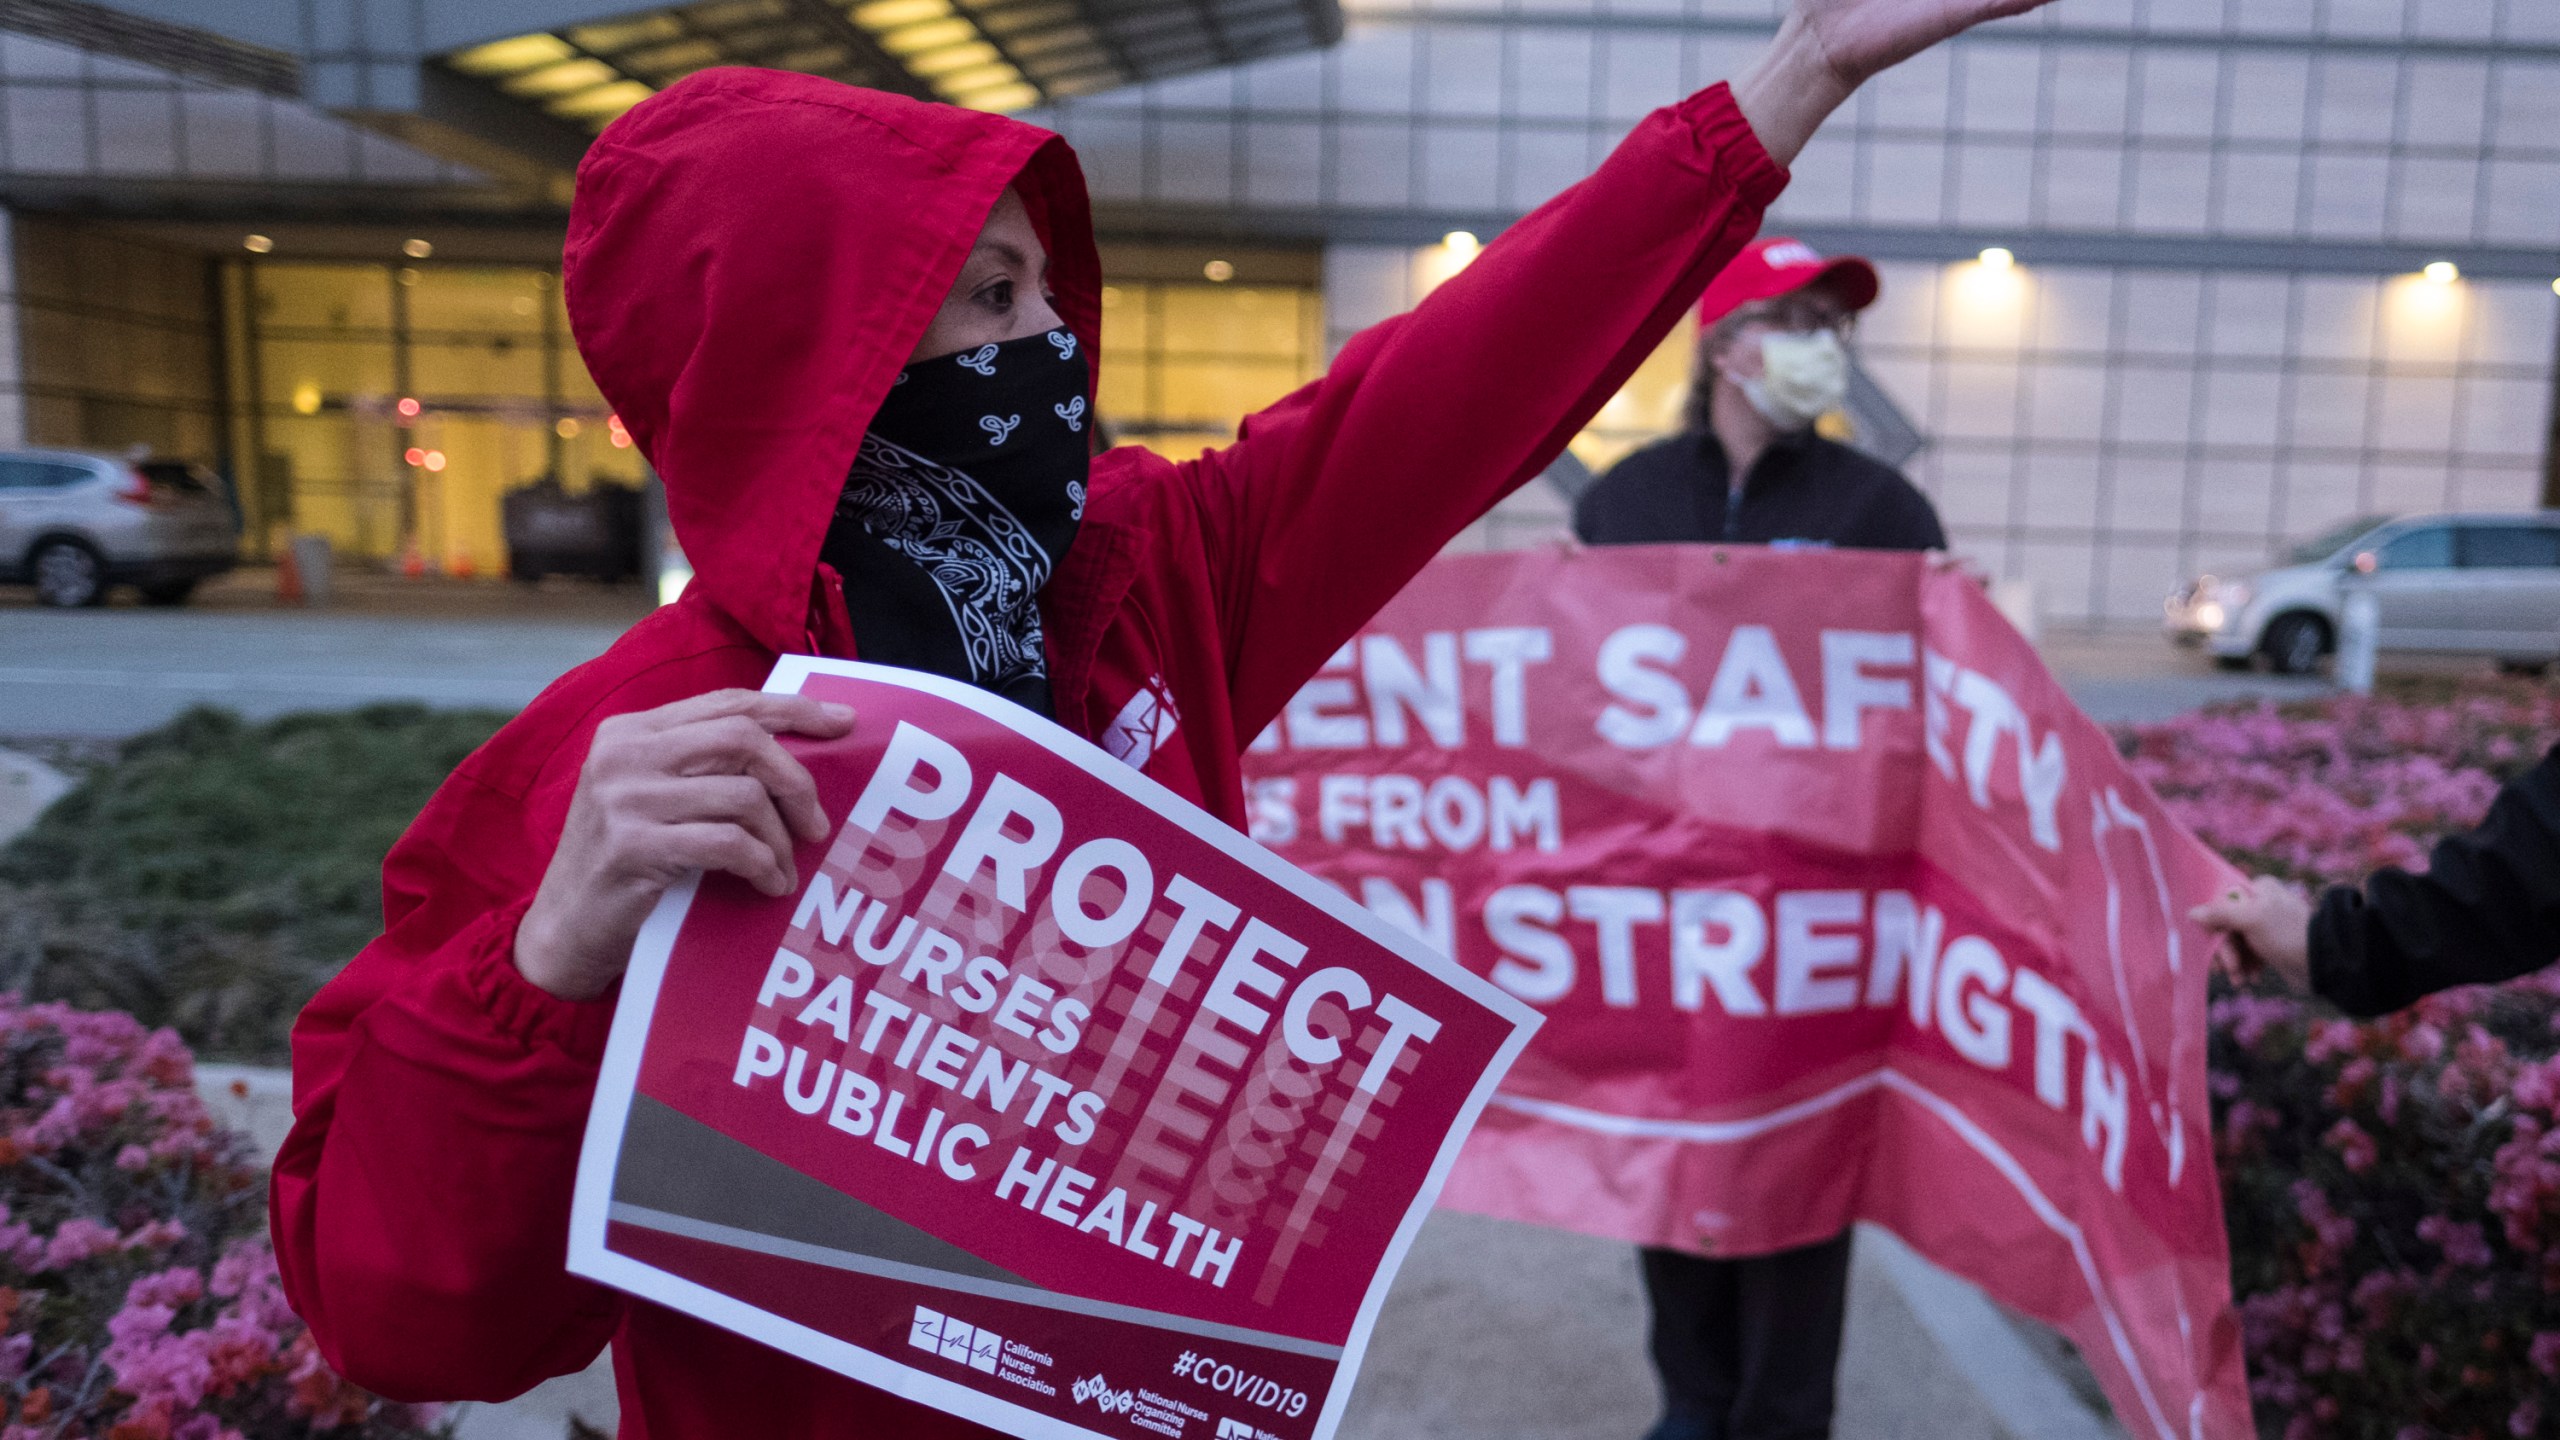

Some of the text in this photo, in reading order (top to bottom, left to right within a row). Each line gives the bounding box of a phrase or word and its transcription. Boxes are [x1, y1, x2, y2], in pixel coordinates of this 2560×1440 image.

[1247, 624, 2066, 853] ENT SAFETY
[1319, 774, 1560, 853] FROM
[847, 720, 1442, 1094] PROTECT
[790, 870, 1091, 1055] NURSES
[757, 947, 1105, 1146] PATIENTS
[1484, 885, 2128, 1193] STRENGTH
[733, 1026, 1243, 1288] PUBLIC HEALTH
[998, 1367, 1056, 1397] Association
[1001, 1353, 1036, 1375] Nurses
[1003, 1339, 1053, 1367] California
[1172, 1350, 1308, 1418] #COVID19
[1130, 1414, 1182, 1440] Committee
[1134, 1401, 1185, 1428] Organizing
[1137, 1388, 1209, 1421] National Nurses
